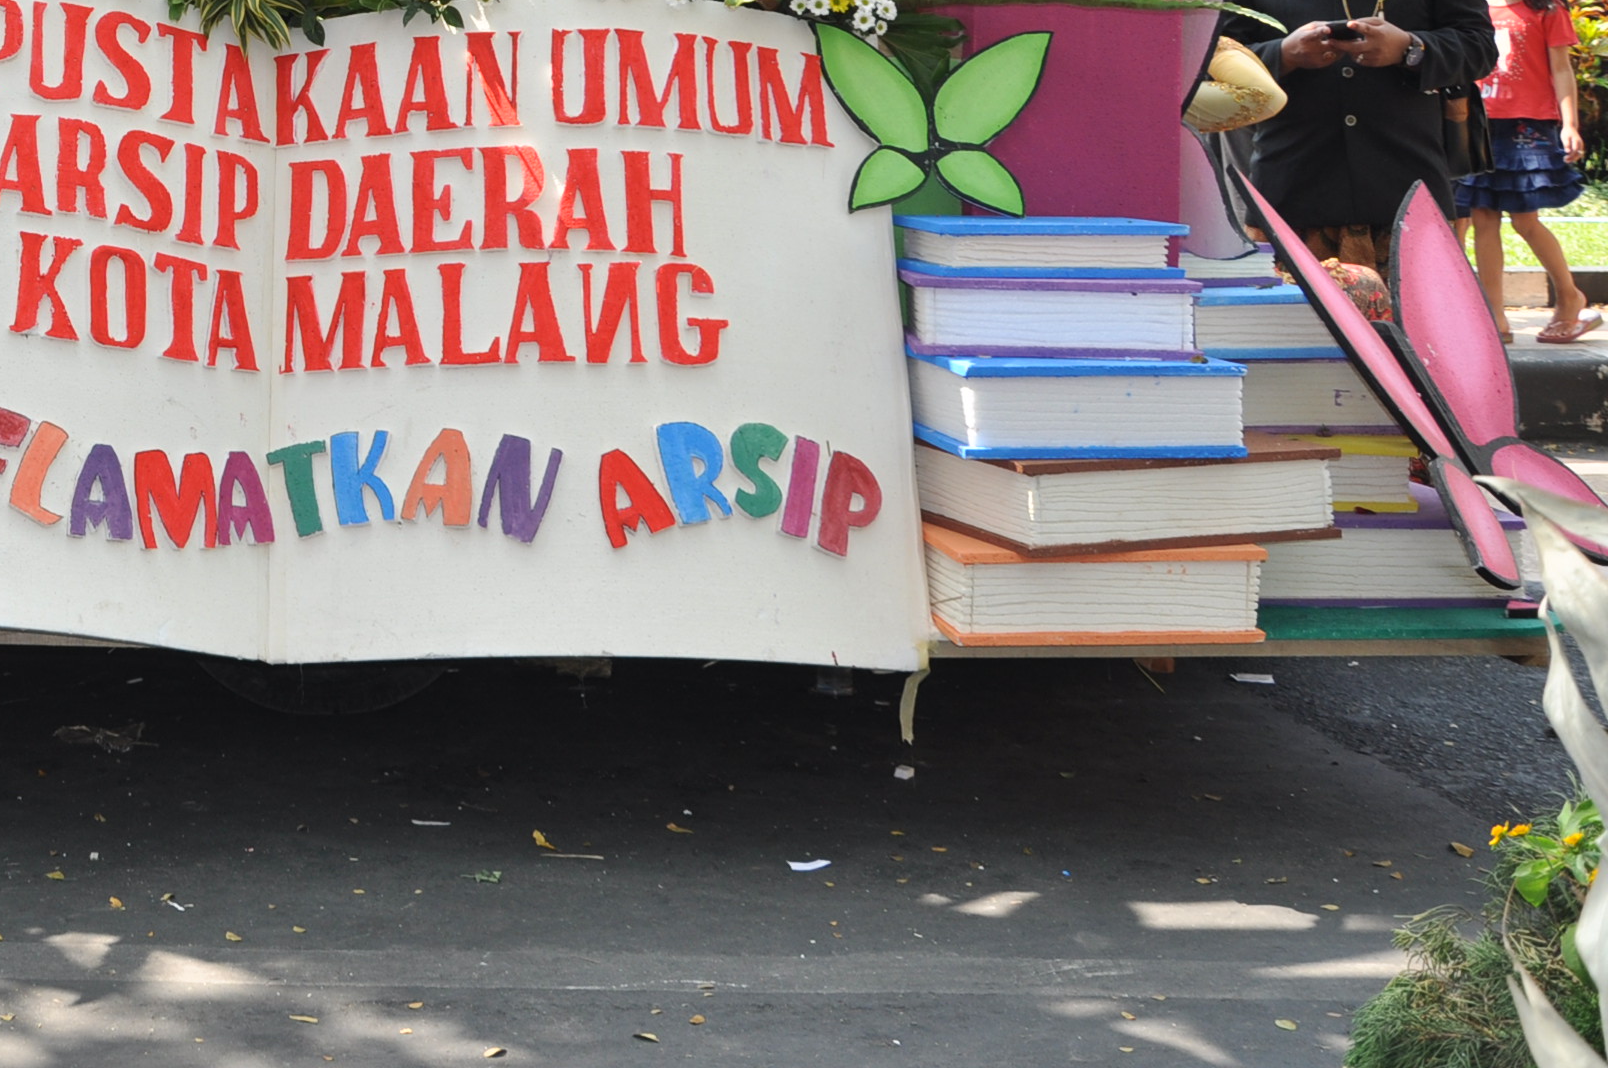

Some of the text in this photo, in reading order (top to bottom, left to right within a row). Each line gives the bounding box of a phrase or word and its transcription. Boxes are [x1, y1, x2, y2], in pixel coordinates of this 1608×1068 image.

[551, 28, 835, 148] UMUM
[286, 145, 688, 260] DAERAH
[9, 231, 730, 374] KOTA MALANG
[598, 421, 882, 558] ARSIP
